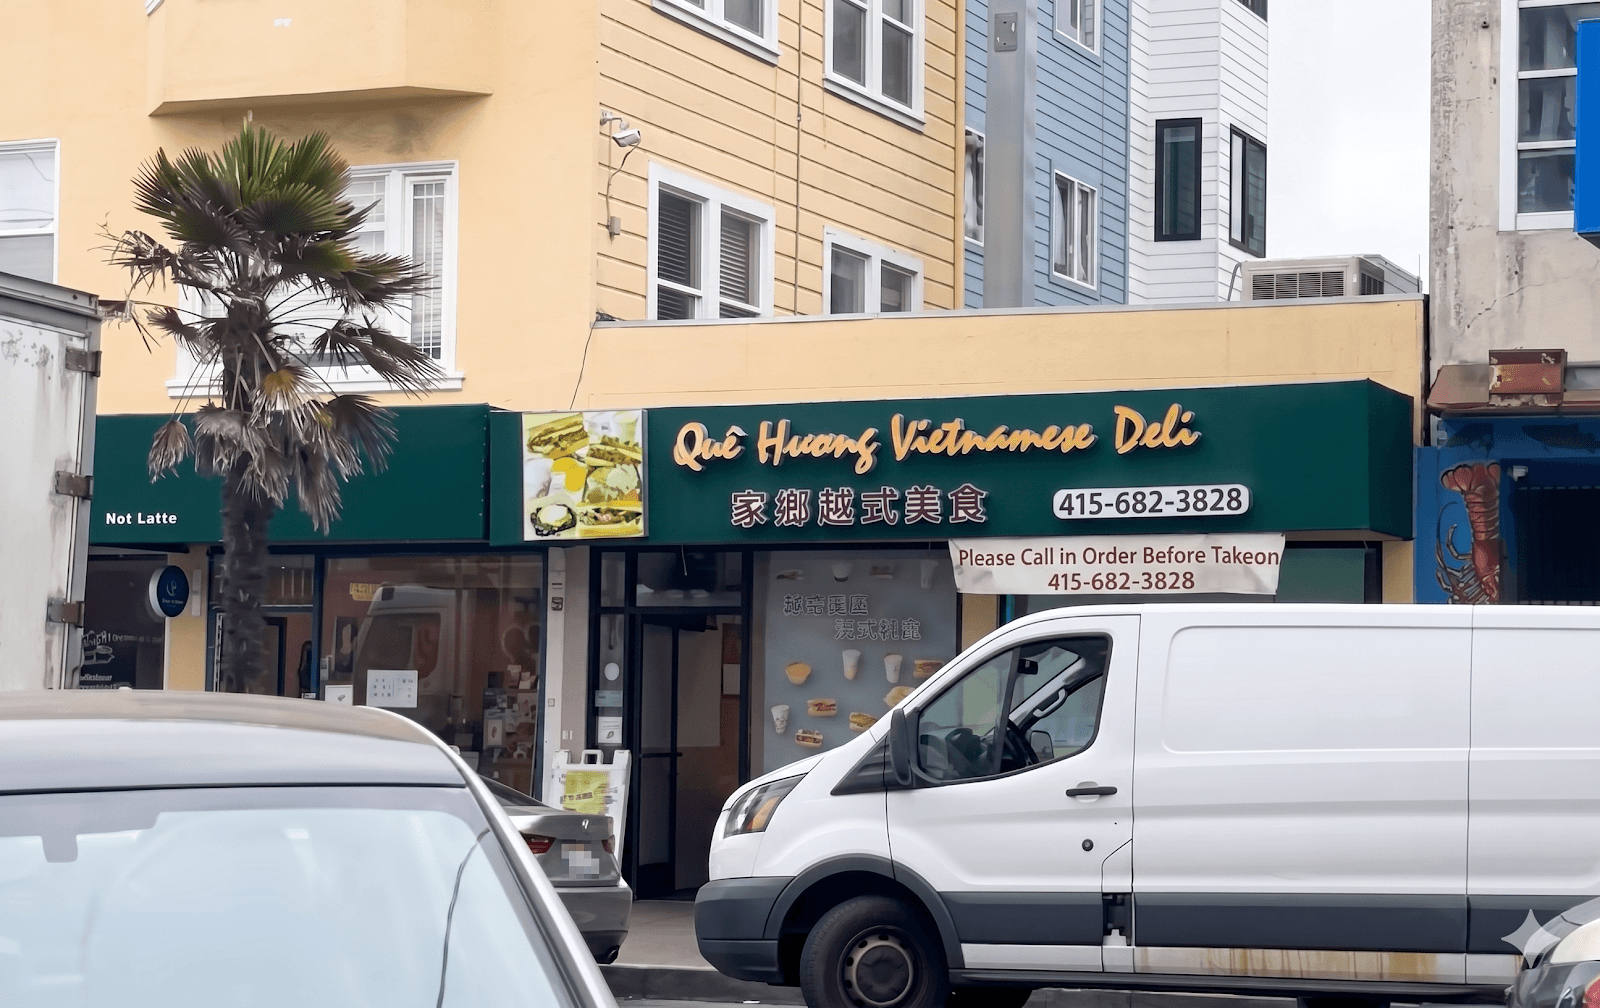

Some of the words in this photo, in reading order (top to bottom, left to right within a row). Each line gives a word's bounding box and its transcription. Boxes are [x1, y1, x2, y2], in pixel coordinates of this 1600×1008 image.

[673, 421, 748, 472] Quê
[891, 413, 1097, 461] Vietnamese
[1114, 403, 1201, 455] Deli
[730, 483, 988, 528] 家鄉越式美食
[1058, 487, 1242, 515] 415-682-3828
[106, 512, 132, 525] Not
[137, 512, 178, 525] Latte
[959, 549, 1015, 566] Please
[1021, 547, 1054, 566] Call
[1060, 547, 1076, 565] in
[1082, 546, 1137, 565] Order
[1143, 546, 1206, 564] Before
[1211, 546, 1279, 565] Takeon
[1047, 571, 1195, 591] 415-682-3828
